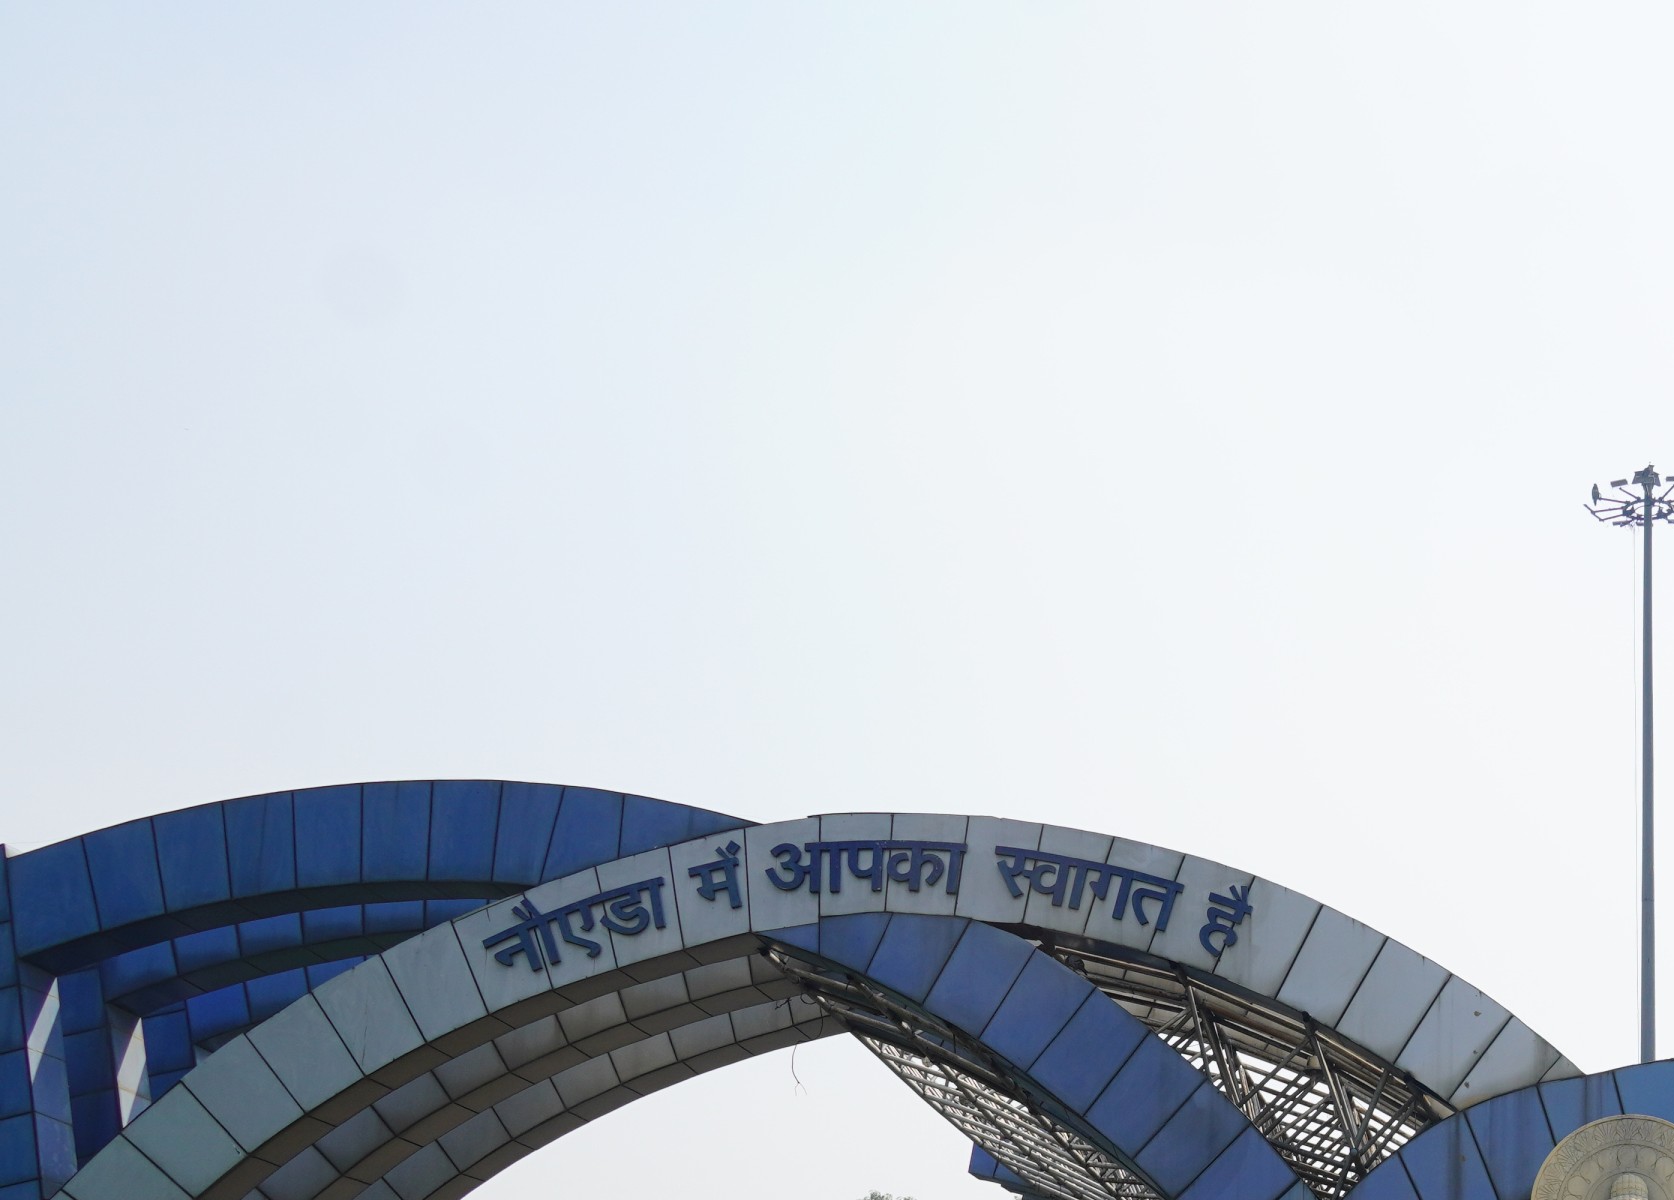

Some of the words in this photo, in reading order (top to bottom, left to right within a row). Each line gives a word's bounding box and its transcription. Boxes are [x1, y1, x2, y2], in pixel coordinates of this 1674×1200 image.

[482, 876, 667, 973] नौएडा
[688, 840, 743, 910] में
[765, 839, 968, 895] आपका
[995, 845, 1185, 932] स्वागत
[1199, 884, 1254, 958] है
